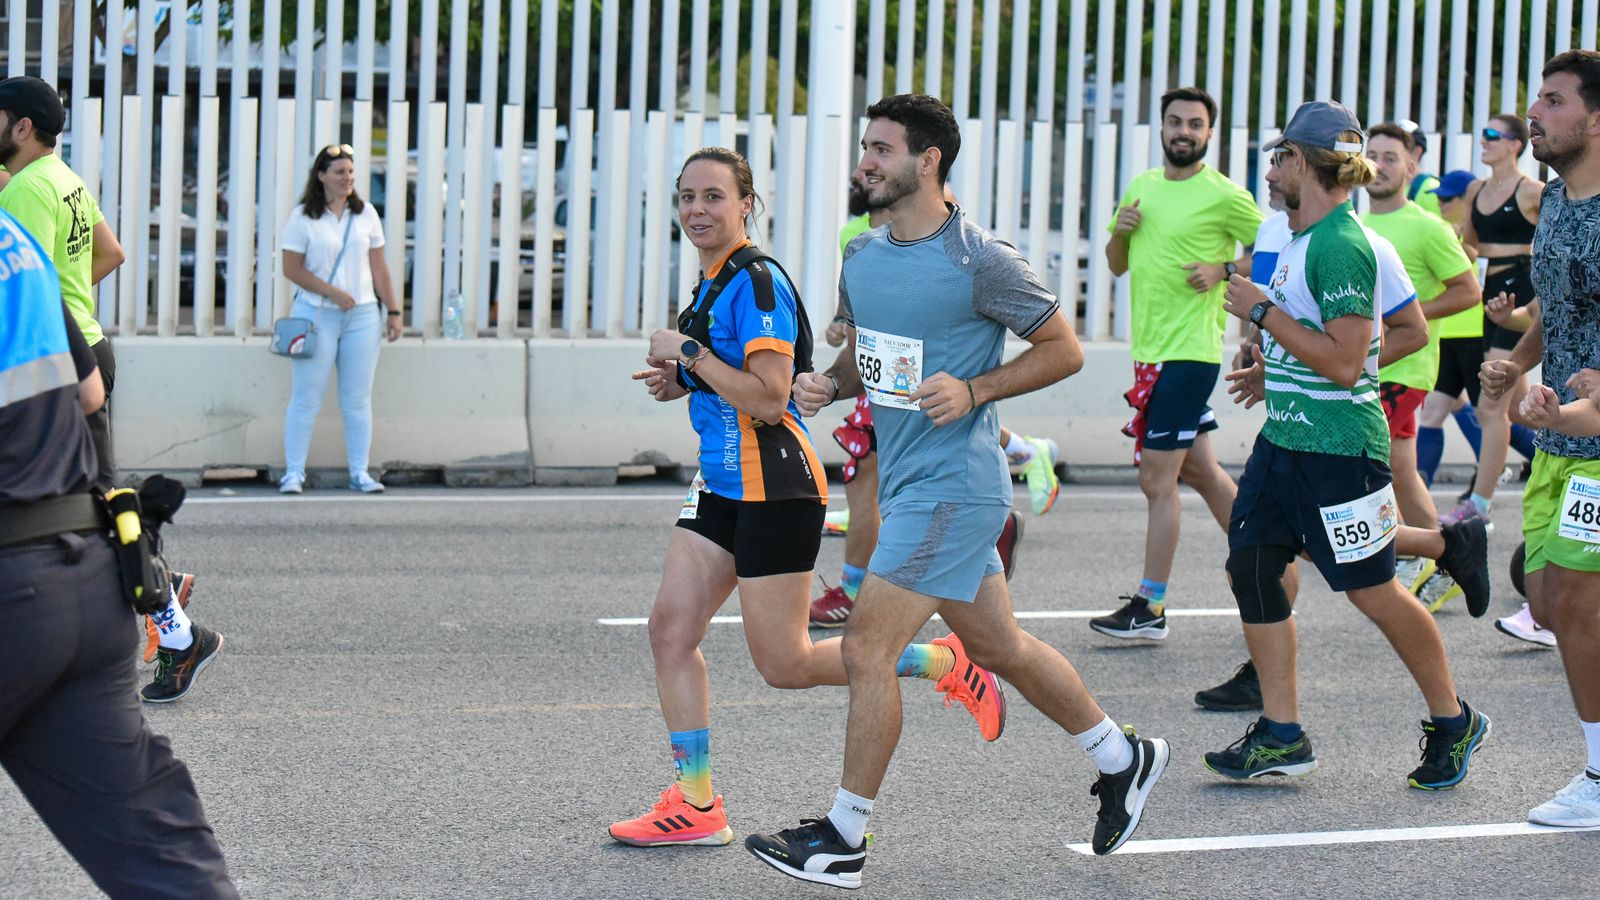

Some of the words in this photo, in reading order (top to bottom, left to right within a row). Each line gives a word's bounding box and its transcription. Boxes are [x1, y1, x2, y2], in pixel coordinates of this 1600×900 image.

[859, 353, 882, 384] 558
[1571, 482, 1585, 493] XXI
[1325, 512, 1339, 521] XXI
[1333, 521, 1371, 547] 559
